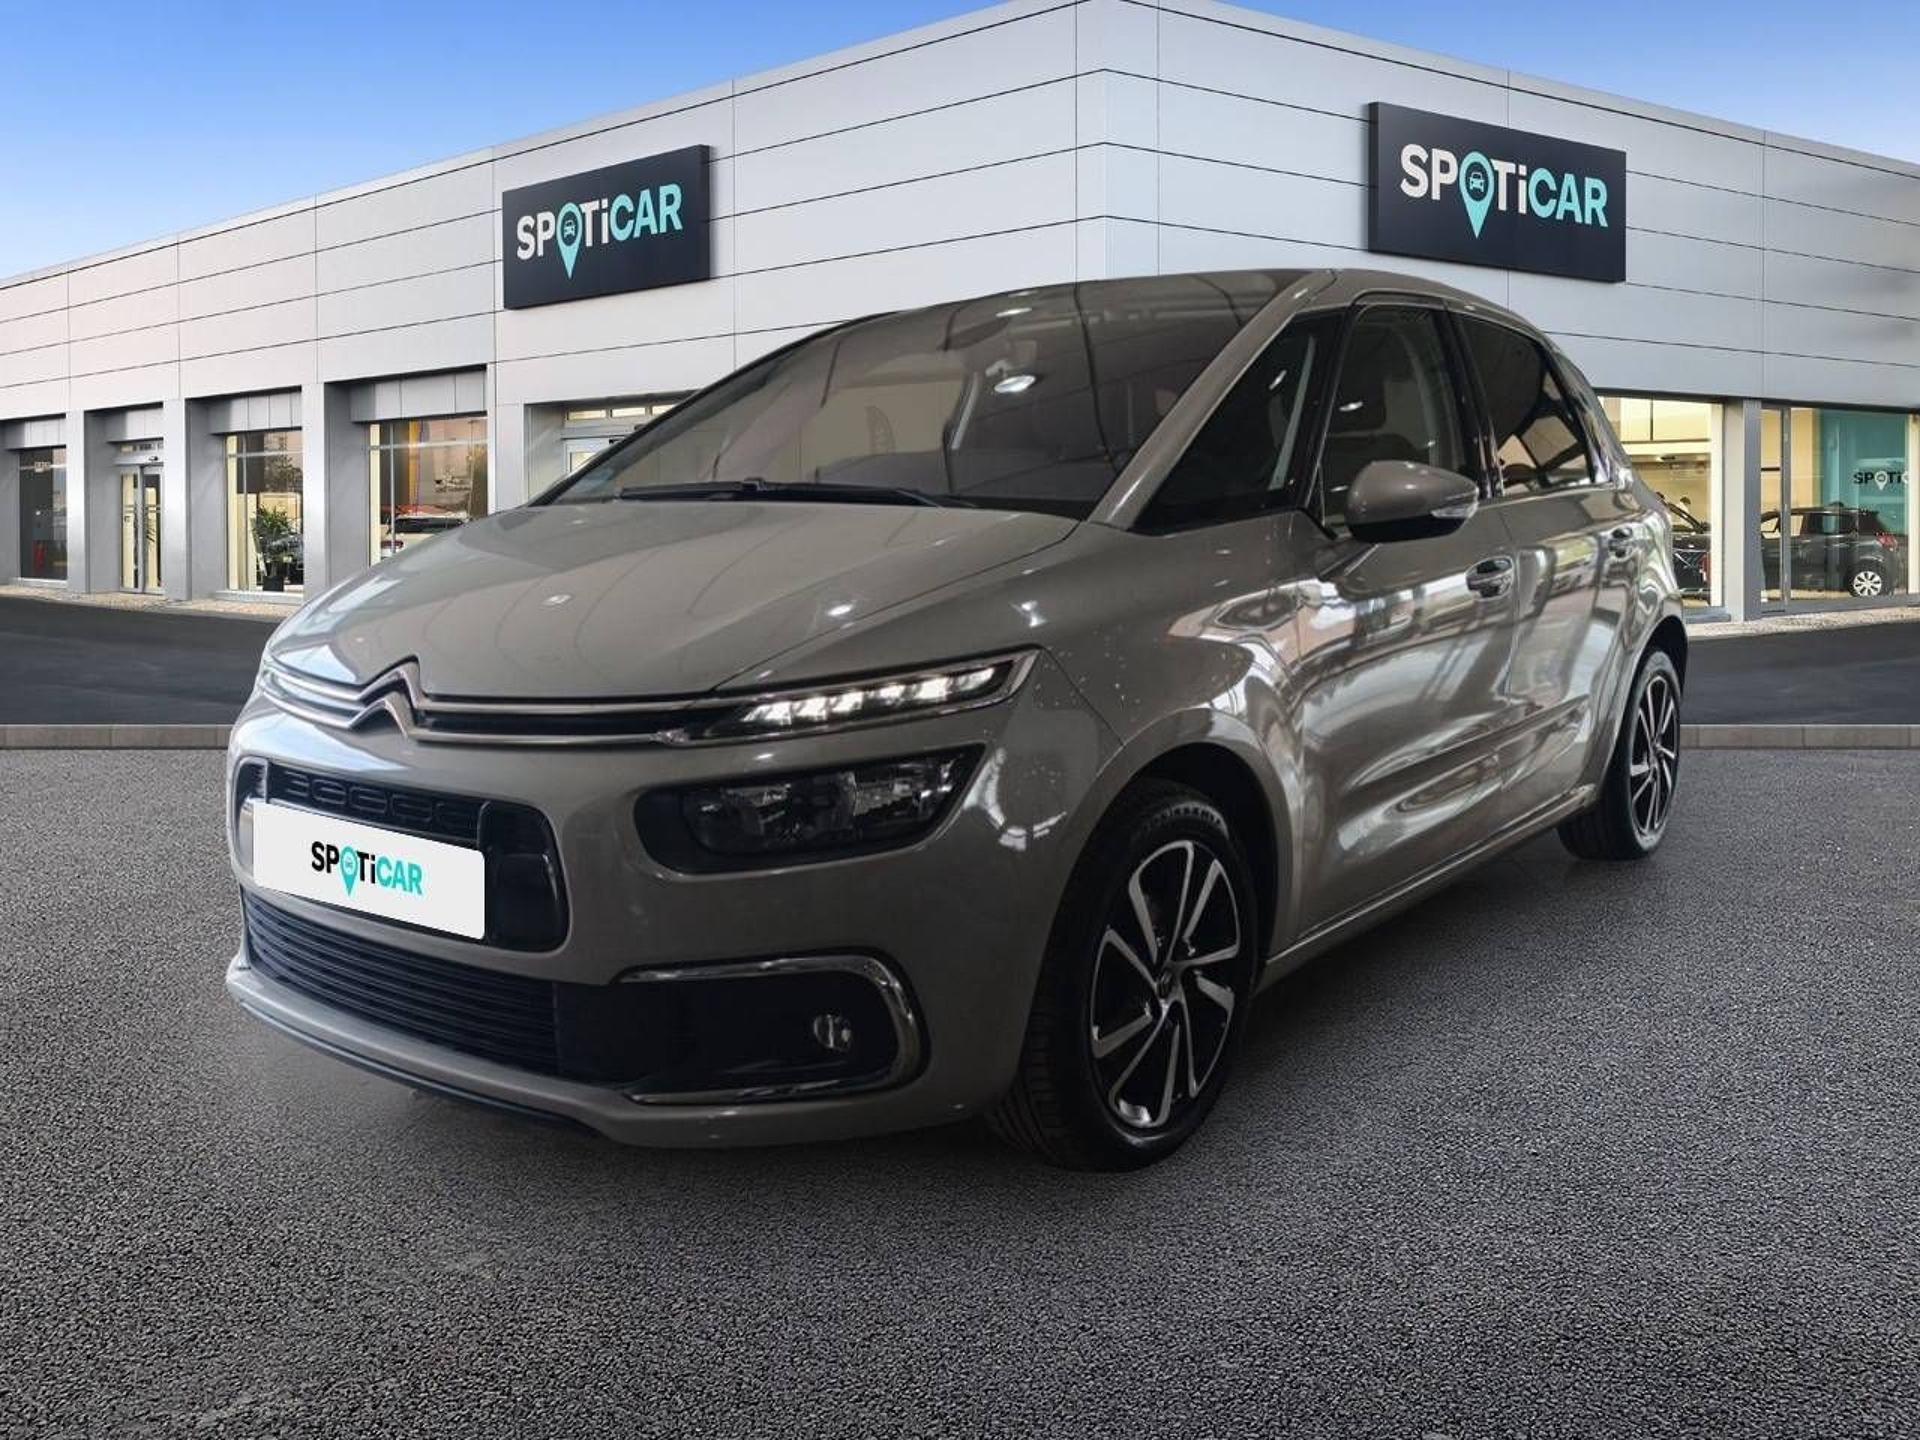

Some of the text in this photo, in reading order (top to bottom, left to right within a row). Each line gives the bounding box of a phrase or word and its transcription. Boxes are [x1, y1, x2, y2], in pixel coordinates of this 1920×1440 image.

[517, 184, 683, 280] SPOTiCAR
[1400, 143, 1609, 239] SPOTiCAR
[311, 841, 422, 896] SPOTiCAR
